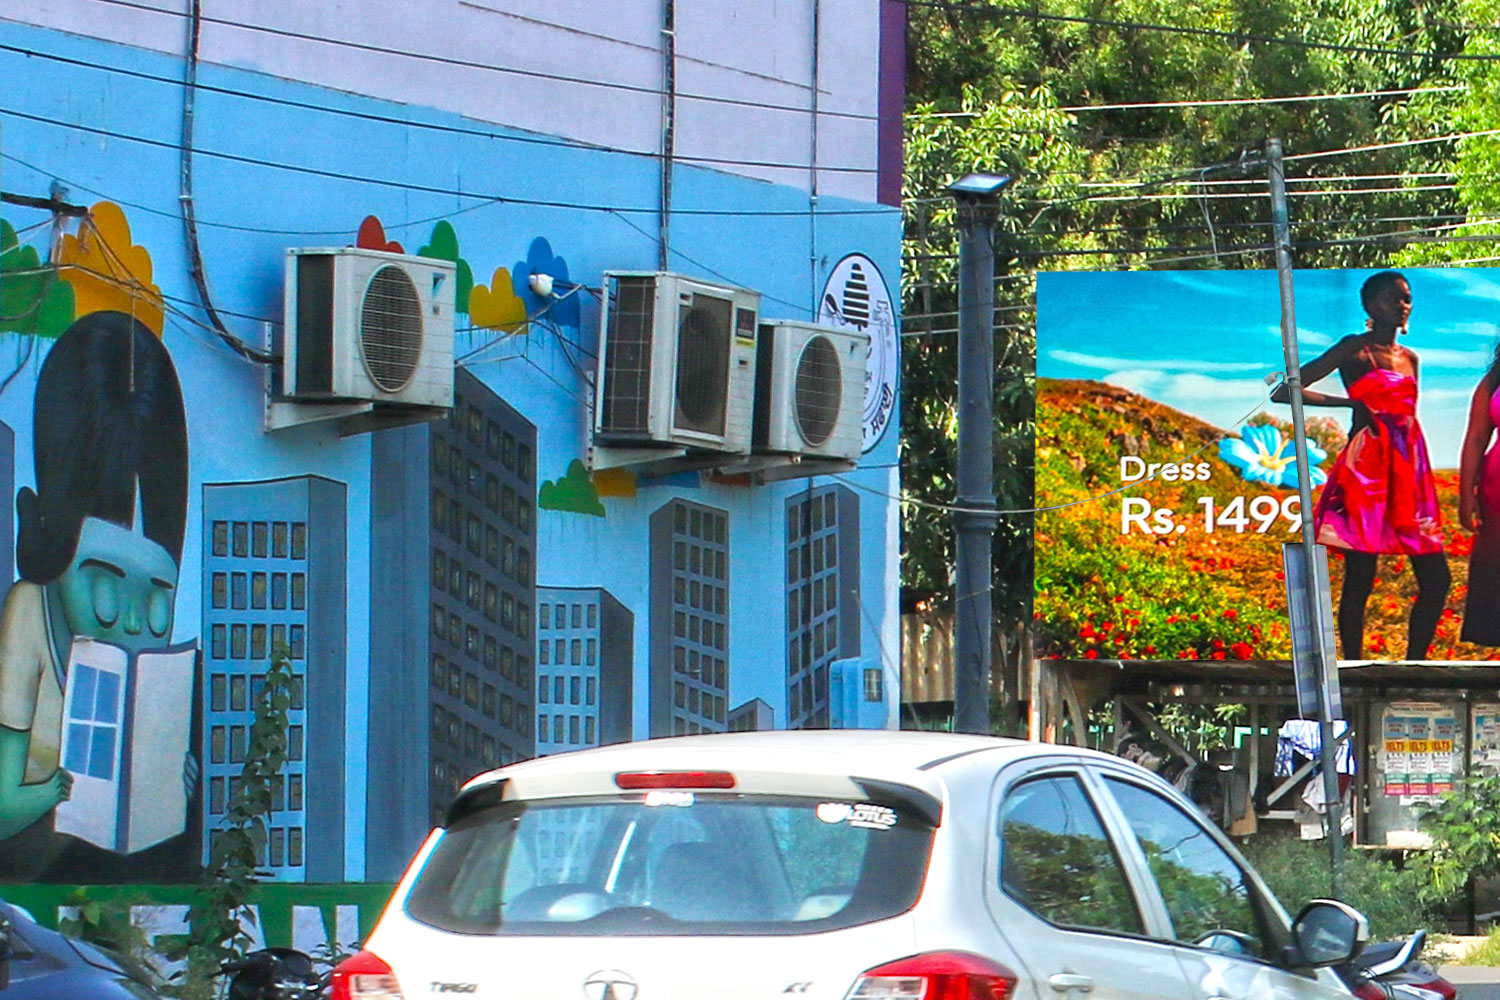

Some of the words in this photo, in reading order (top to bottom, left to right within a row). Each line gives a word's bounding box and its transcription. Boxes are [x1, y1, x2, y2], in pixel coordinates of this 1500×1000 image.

[1120, 456, 1211, 482] Dress
[1122, 497, 1187, 534] Rs.
[1197, 495, 1304, 534] 1499
[846, 810, 898, 826] LOTUS
